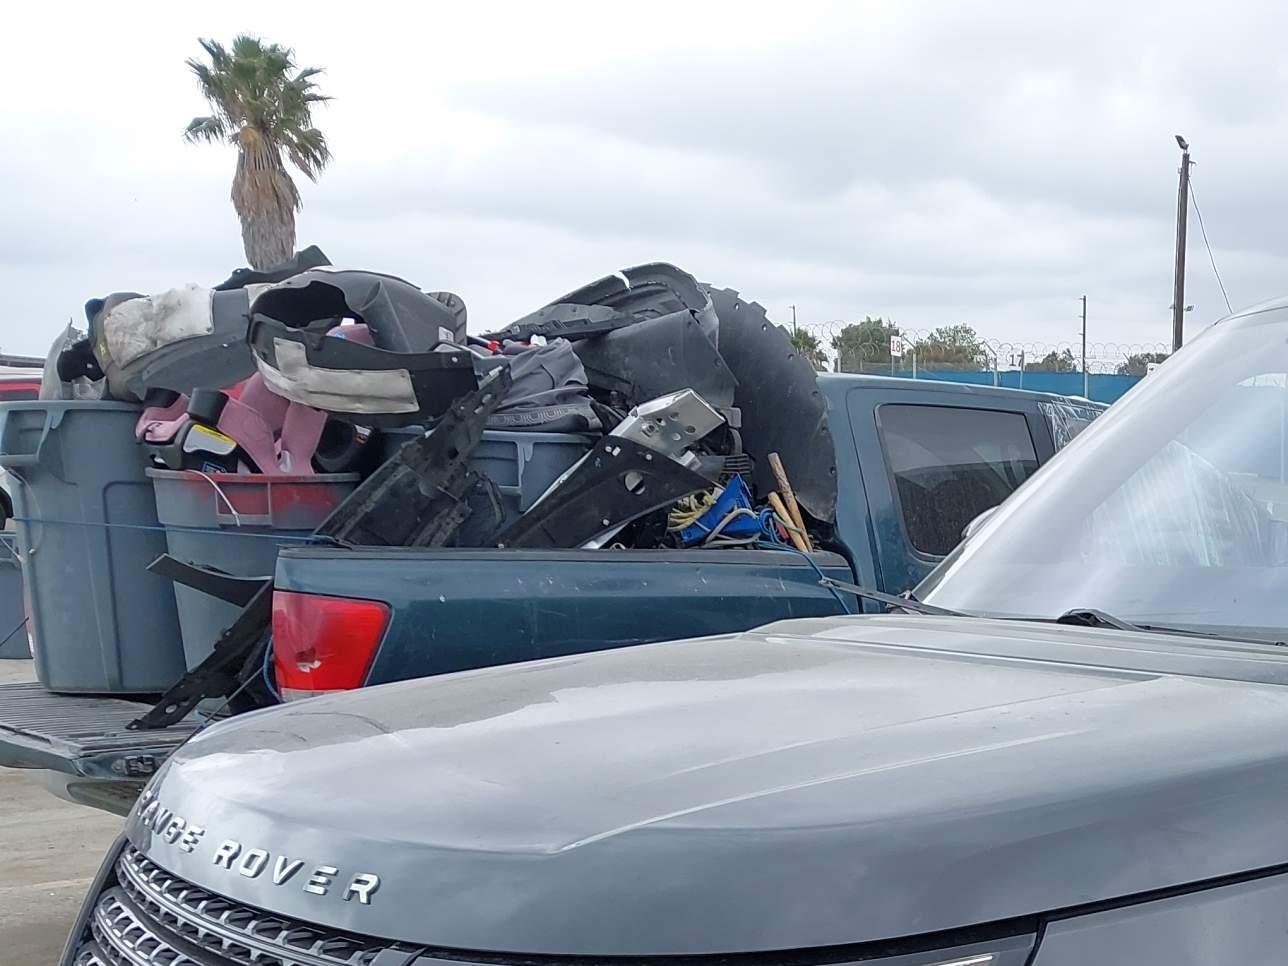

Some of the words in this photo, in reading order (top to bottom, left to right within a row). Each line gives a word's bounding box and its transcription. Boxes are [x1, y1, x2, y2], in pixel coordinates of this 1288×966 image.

[891, 340, 901, 353] 18
[1008, 354, 1024, 367] 17
[213, 839, 381, 905] ROVER
